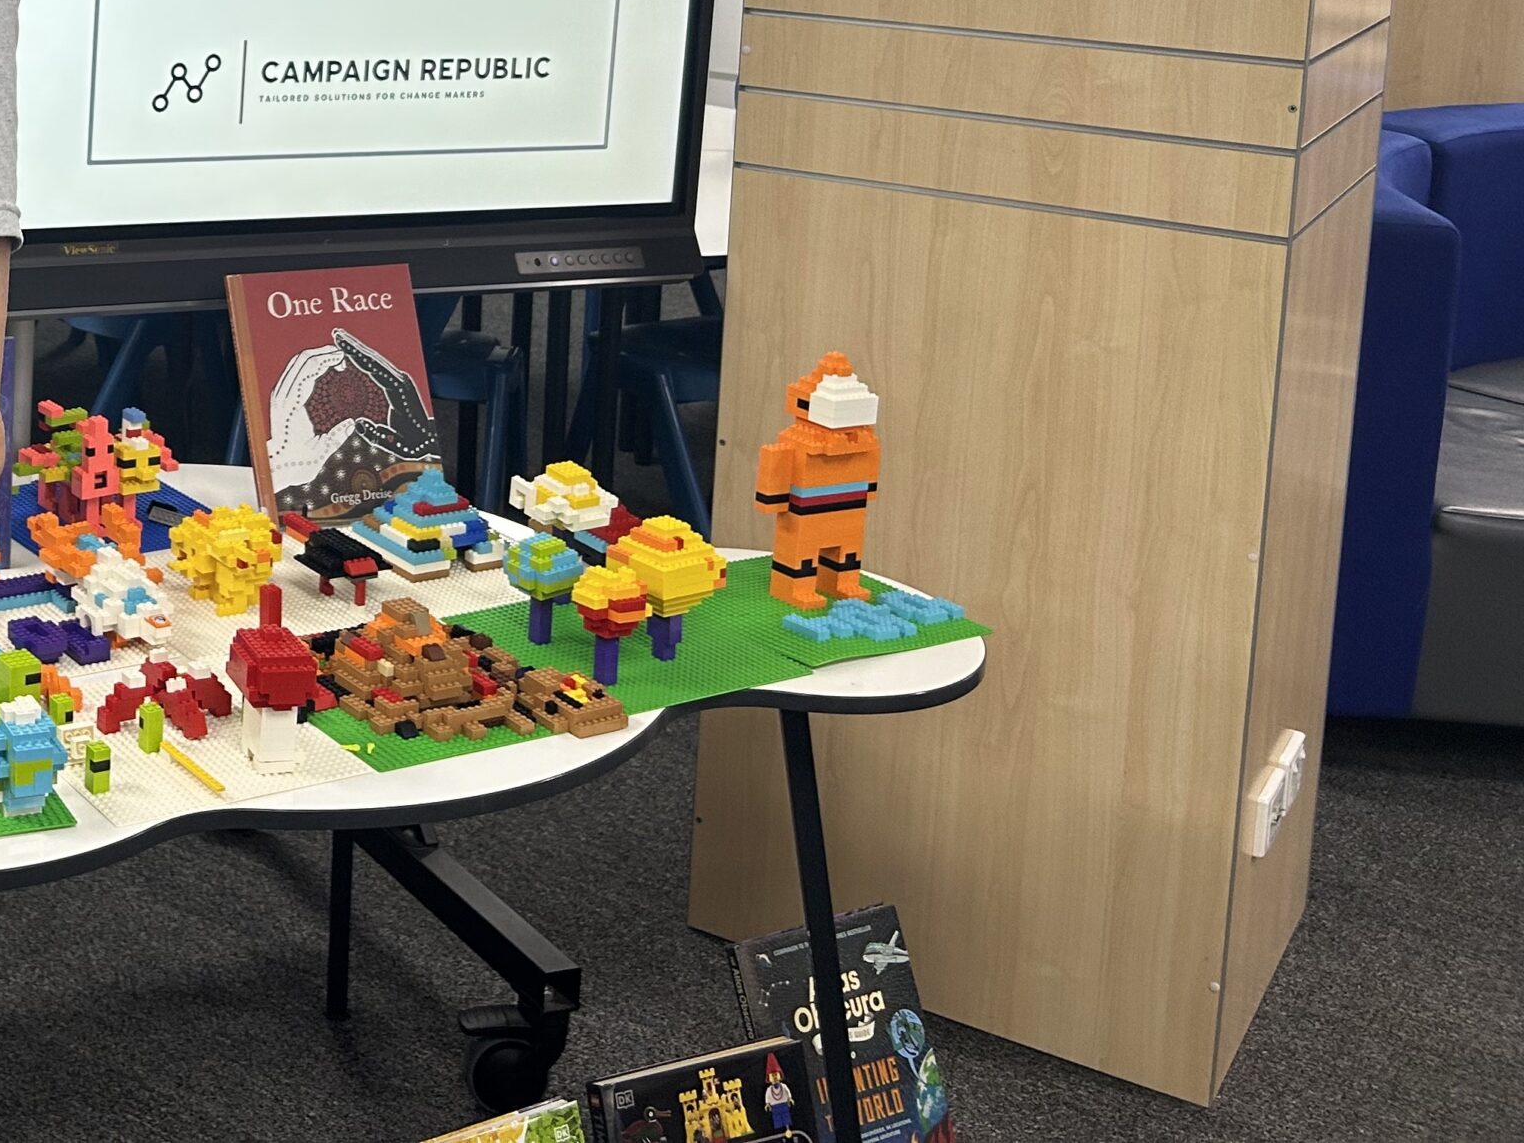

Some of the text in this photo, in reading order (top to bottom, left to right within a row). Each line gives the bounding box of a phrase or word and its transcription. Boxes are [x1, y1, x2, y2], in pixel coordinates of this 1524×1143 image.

[260, 56, 551, 84] CAMPAIGN REPUBLIC
[259, 90, 486, 103] TAILORED SOLUTIONS FOR CHANGE MAKERS
[267, 286, 394, 319] One Race
[330, 492, 362, 506] Gregg
[731, 968, 745, 994] Atlas
[618, 1092, 632, 1106] DK
[556, 1128, 568, 1140] DK
